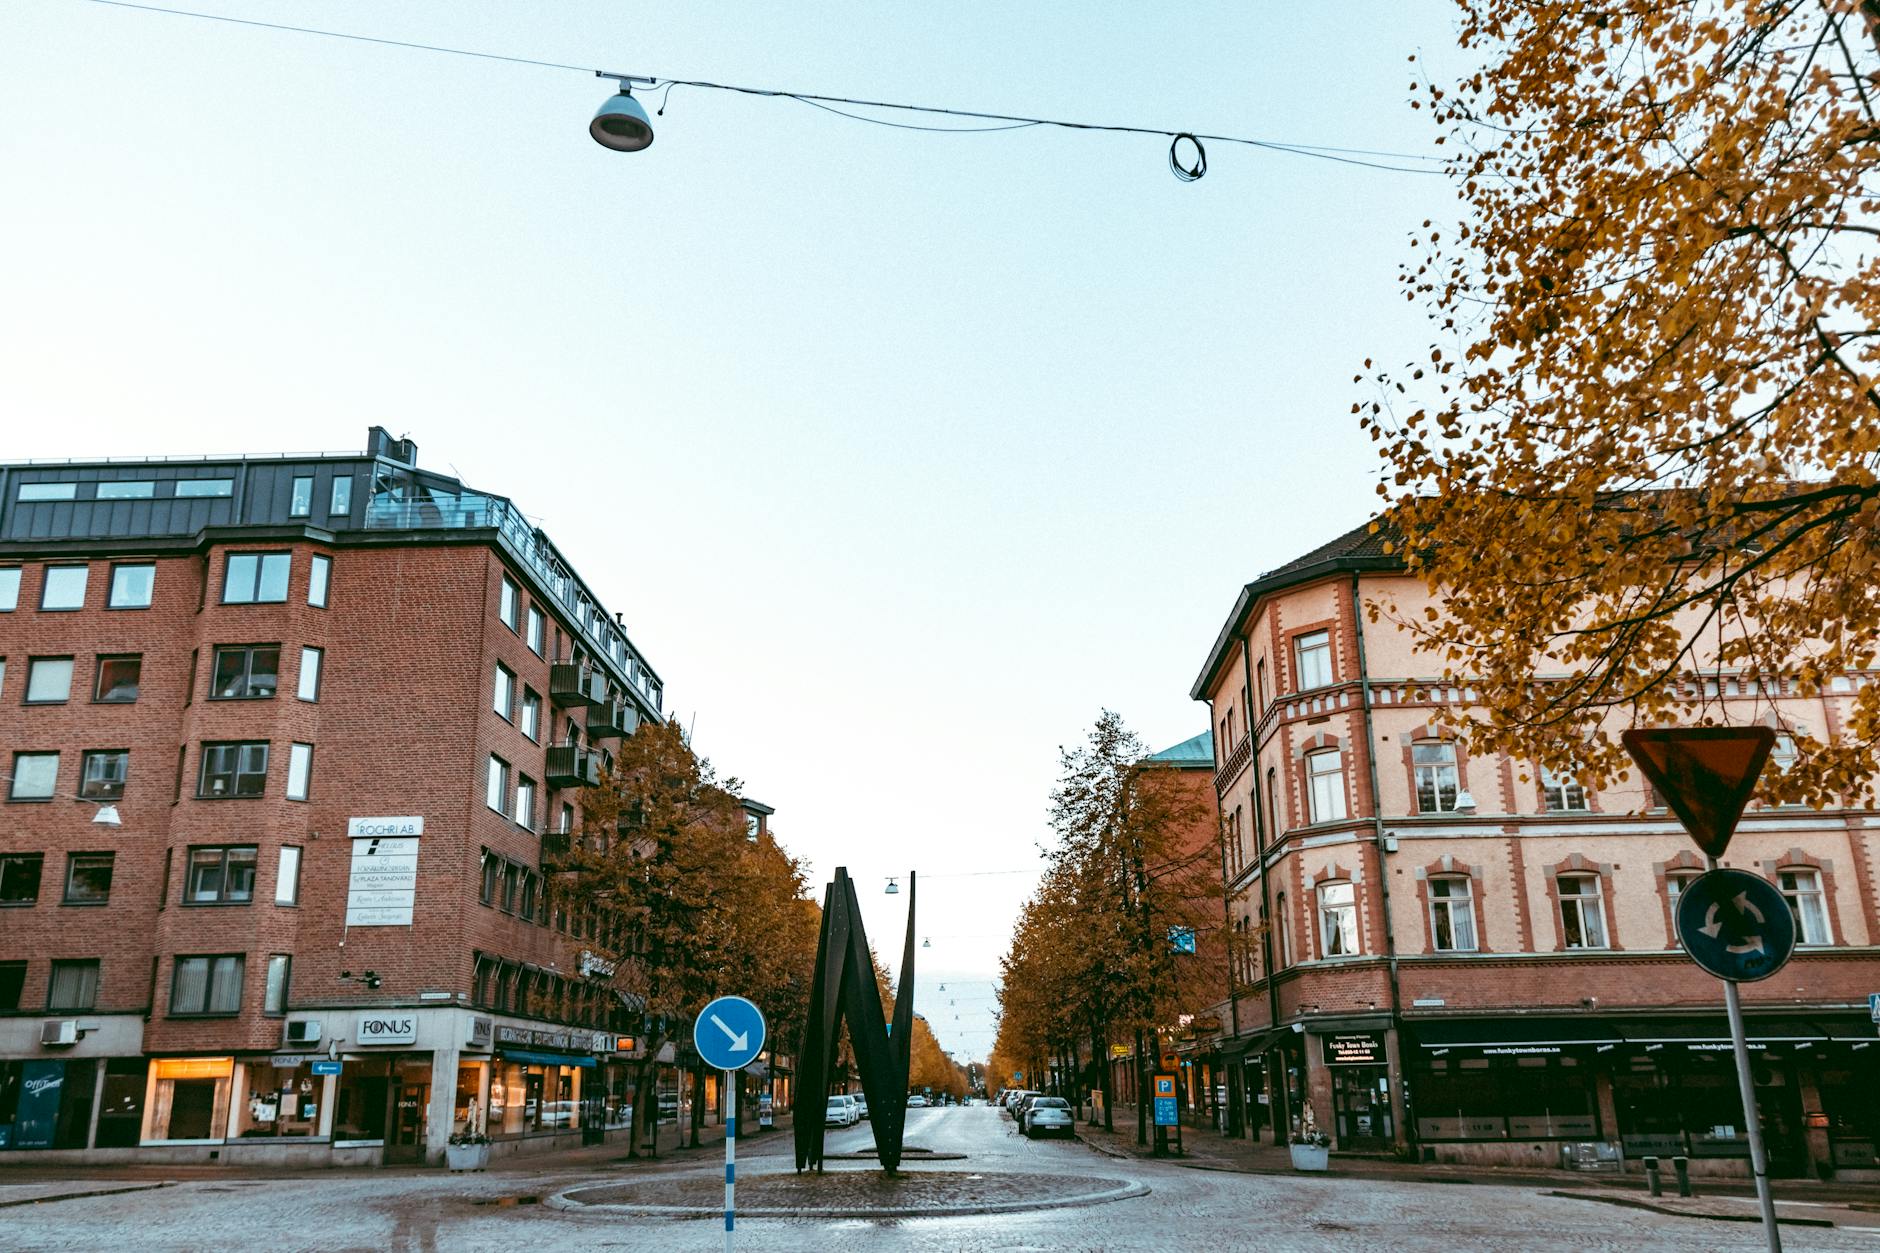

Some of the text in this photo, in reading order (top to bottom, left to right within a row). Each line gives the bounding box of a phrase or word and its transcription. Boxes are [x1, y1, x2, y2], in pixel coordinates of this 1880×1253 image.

[400, 825, 414, 834] AB
[363, 1019, 412, 1035] FONUS
[1161, 1080, 1169, 1092] P
